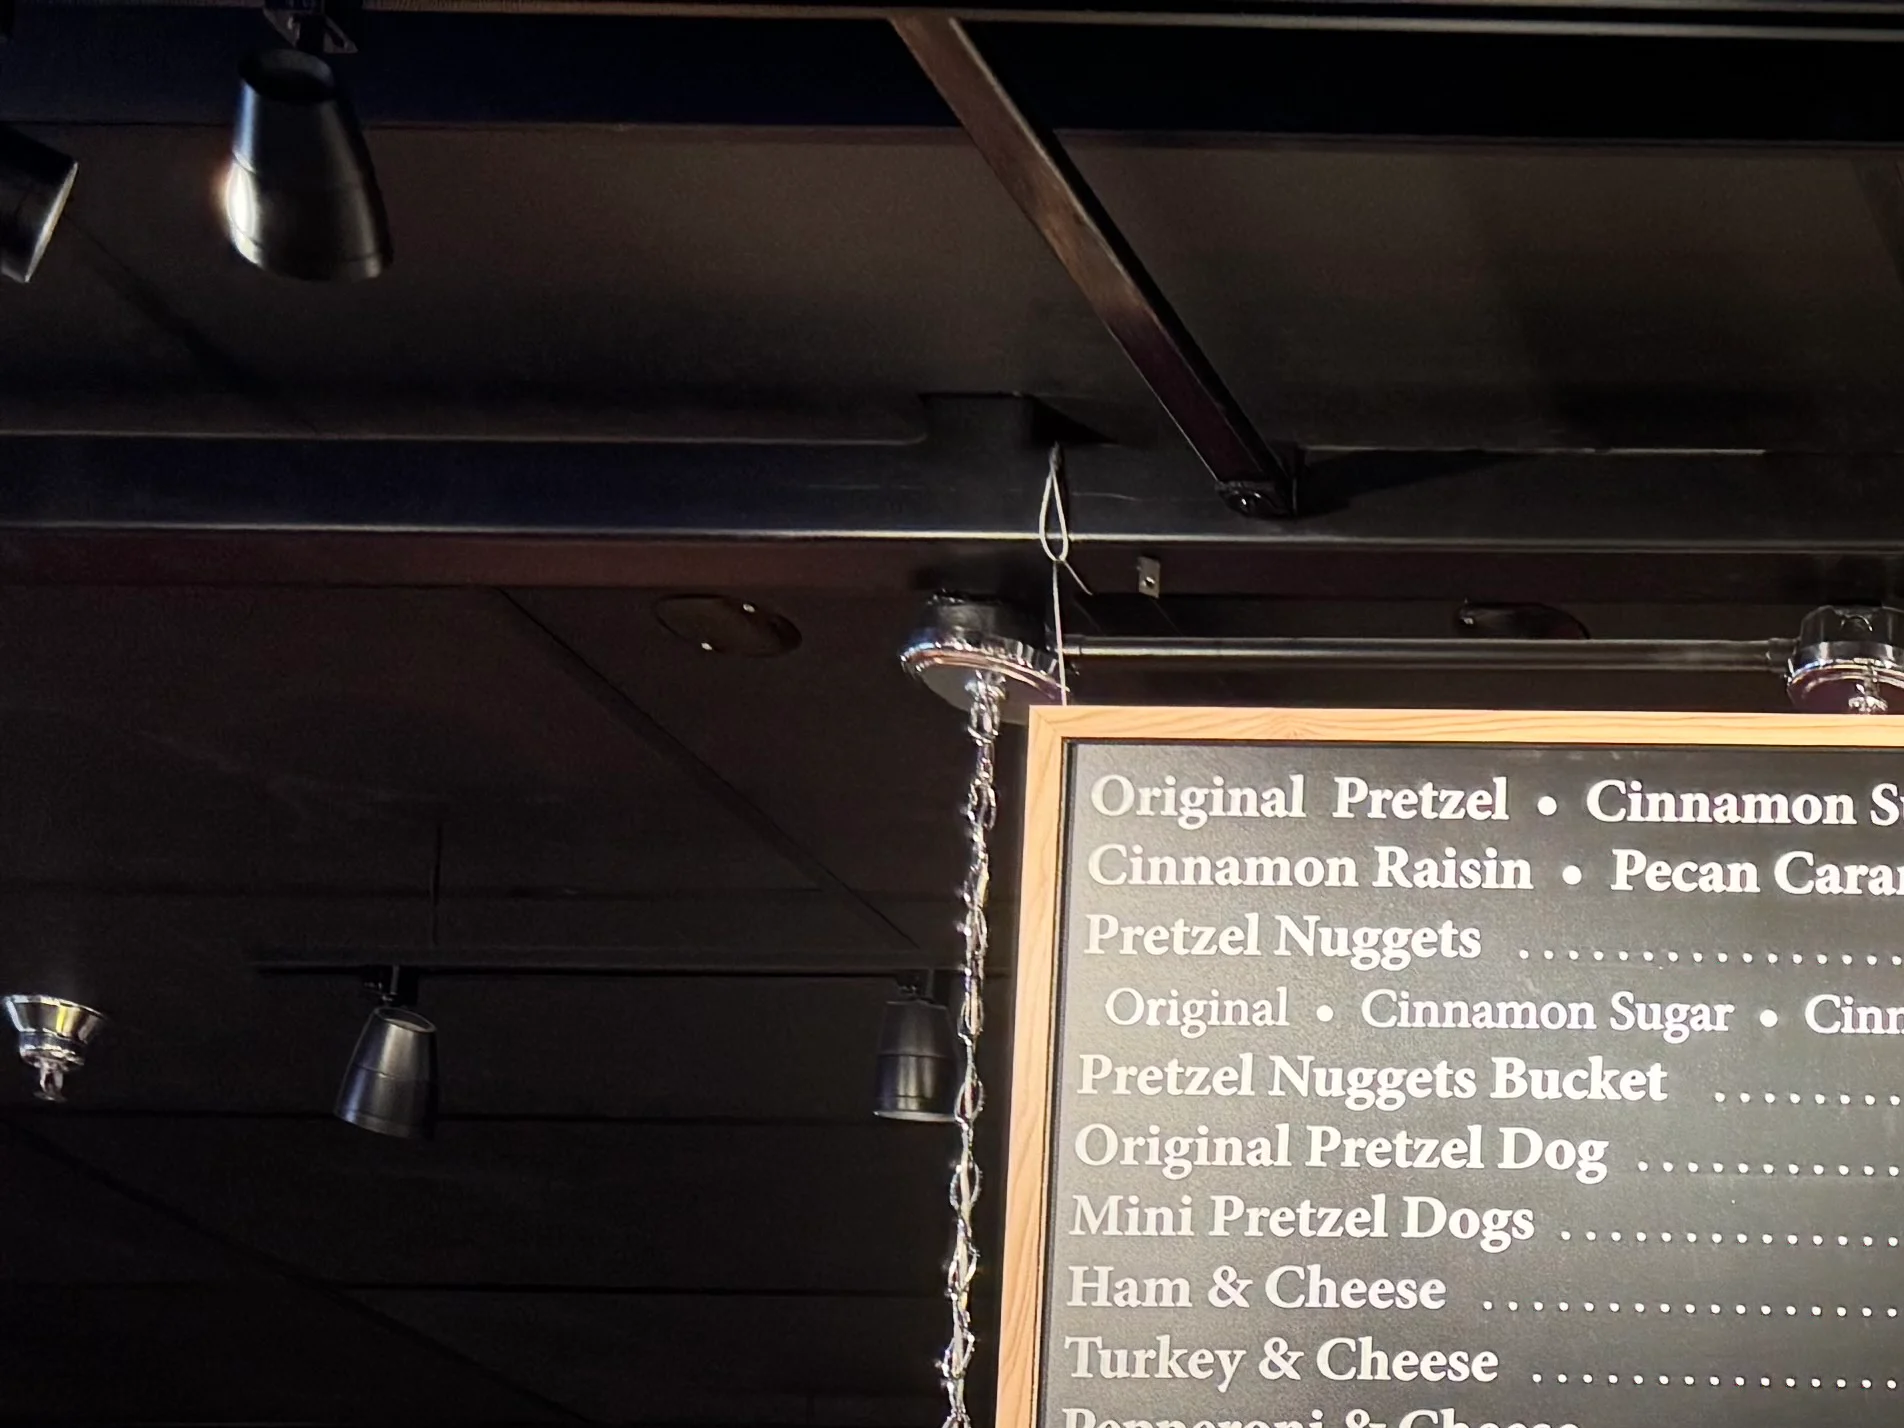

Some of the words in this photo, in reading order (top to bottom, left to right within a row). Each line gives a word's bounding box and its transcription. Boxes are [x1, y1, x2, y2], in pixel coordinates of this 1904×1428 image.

[1092, 775, 1306, 829] Original
[1333, 777, 1509, 820] Pretzel
[1587, 780, 1857, 824] Cinnamon
[1089, 844, 1358, 886] Cinnamon
[1372, 846, 1533, 889] Raisin
[1611, 849, 1760, 892] Pecan
[1084, 913, 1261, 955] Pretzel
[1274, 915, 1481, 970] Nuggets
[1106, 987, 1289, 1038] Original
[1362, 989, 1596, 1029] Cinnamon
[1610, 991, 1734, 1043] Sugar
[1077, 1053, 1254, 1095] Pretzel
[1268, 1056, 1476, 1110] Nuggets
[1490, 1056, 1667, 1100] Bucket
[1075, 1124, 1291, 1179] Original
[1306, 1125, 1484, 1168] Pretzel
[1498, 1128, 1609, 1184] Dog
[1069, 1195, 1194, 1235] Mini
[1209, 1194, 1388, 1237] Pretzel
[1401, 1197, 1534, 1252] Dogs
[1067, 1266, 1192, 1307] Ham
[1208, 1266, 1253, 1307] &
[1266, 1264, 1445, 1309] Cheese
[1064, 1335, 1246, 1392] Turkey
[1259, 1337, 1304, 1379] &
[1317, 1336, 1498, 1381] Cheese
